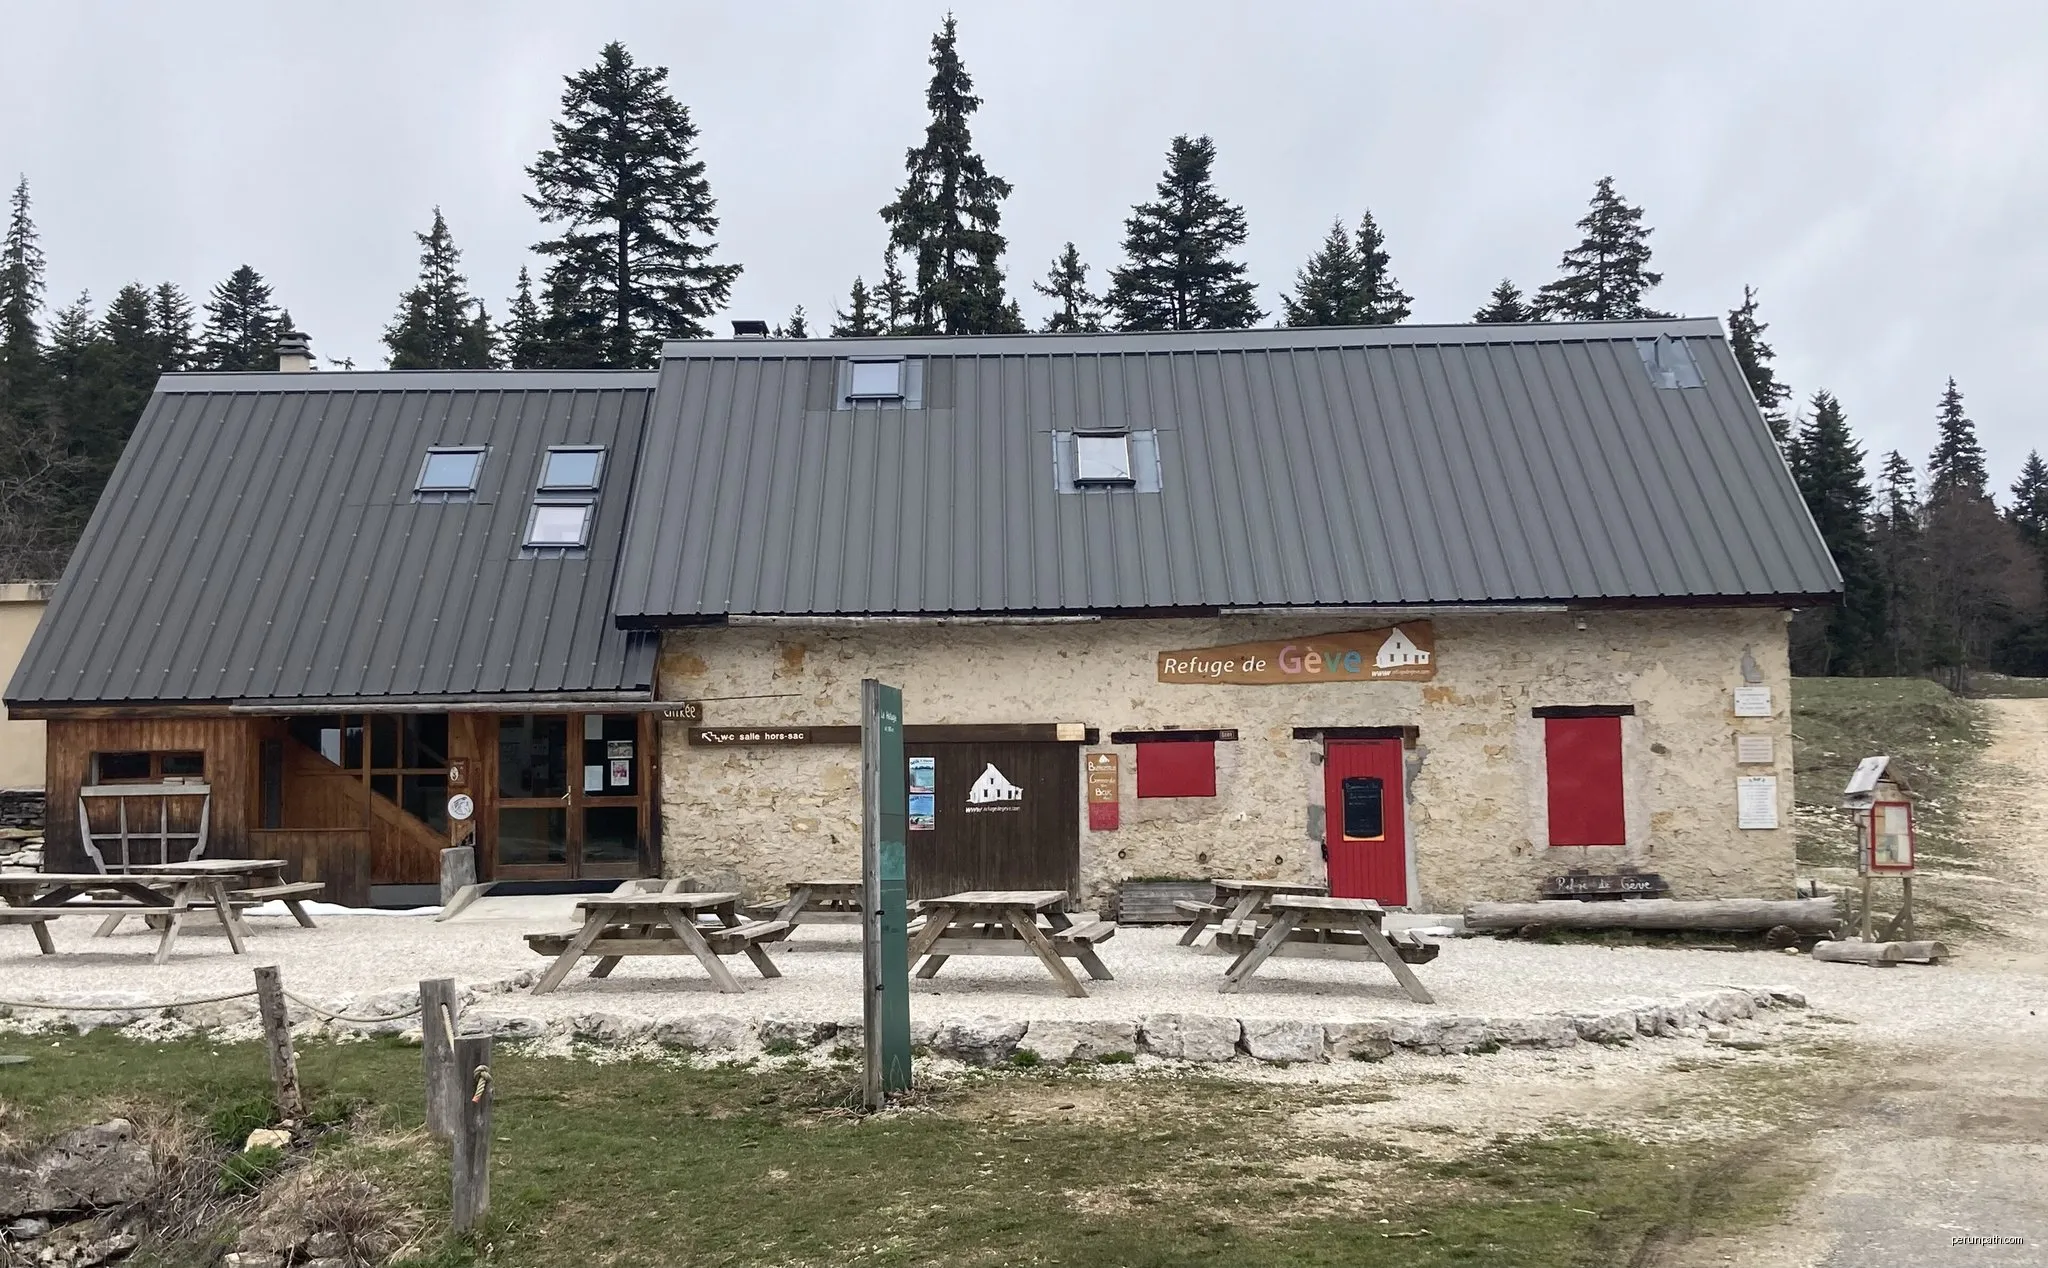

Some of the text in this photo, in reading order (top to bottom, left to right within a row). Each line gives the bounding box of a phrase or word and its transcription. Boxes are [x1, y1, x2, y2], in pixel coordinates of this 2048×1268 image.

[1164, 646, 1362, 677] Refuge de Gève
[739, 732, 760, 741] salle
[765, 732, 804, 740] hors-sac
